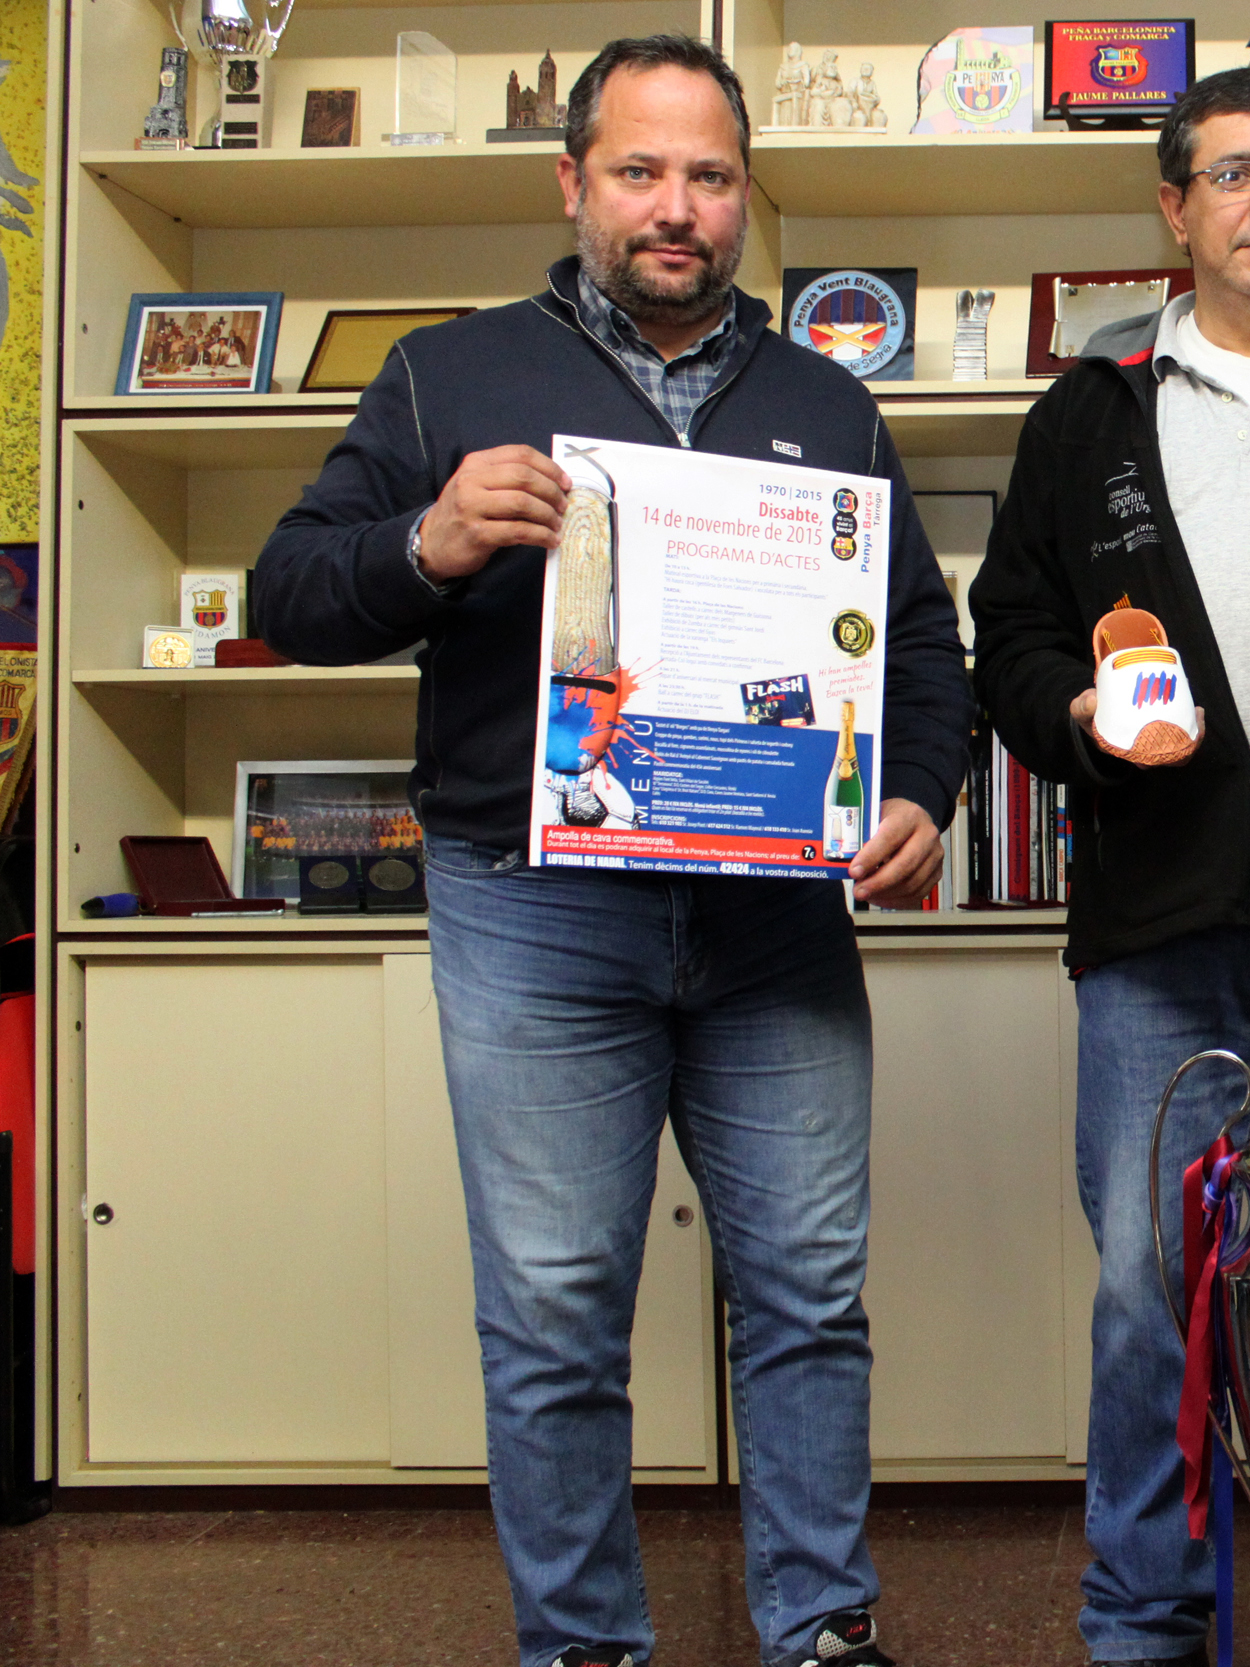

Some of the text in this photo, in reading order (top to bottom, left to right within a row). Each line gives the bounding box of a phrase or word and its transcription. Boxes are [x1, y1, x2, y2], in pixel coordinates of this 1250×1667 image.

[1062, 26, 1176, 34] PEÑA BARCELONISTA
[1071, 90, 1167, 102] JAUME PALLARES
[794, 277, 899, 328] Penya Vent Blaugrana
[759, 484, 822, 501] 1970 2015
[1108, 488, 1145, 514] esportiu
[1109, 485, 1131, 500] consell
[758, 501, 824, 526] Dissabte,
[642, 506, 822, 546] 14 de novembre de 2015
[861, 492, 874, 573] Penya Barça
[667, 540, 821, 572] PROGRAMA D'ACTES
[828, 667, 841, 675] han
[843, 660, 872, 676] ampolles
[746, 676, 804, 700] FLASH
[848, 685, 854, 694] la
[856, 681, 873, 691] teva!
[547, 830, 675, 846] Ampolla de cava commemorativa.
[804, 847, 814, 858] 7€
[546, 853, 583, 865] LOTERIA
[584, 855, 596, 866] DE
[597, 856, 627, 868] NADAL.
[628, 860, 654, 869] Tenim
[654, 862, 683, 872] dècims
[684, 864, 697, 872] del
[698, 864, 718, 873] núm.
[720, 862, 749, 874] 42424
[756, 867, 763, 875] la
[789, 869, 828, 878] disposició.
